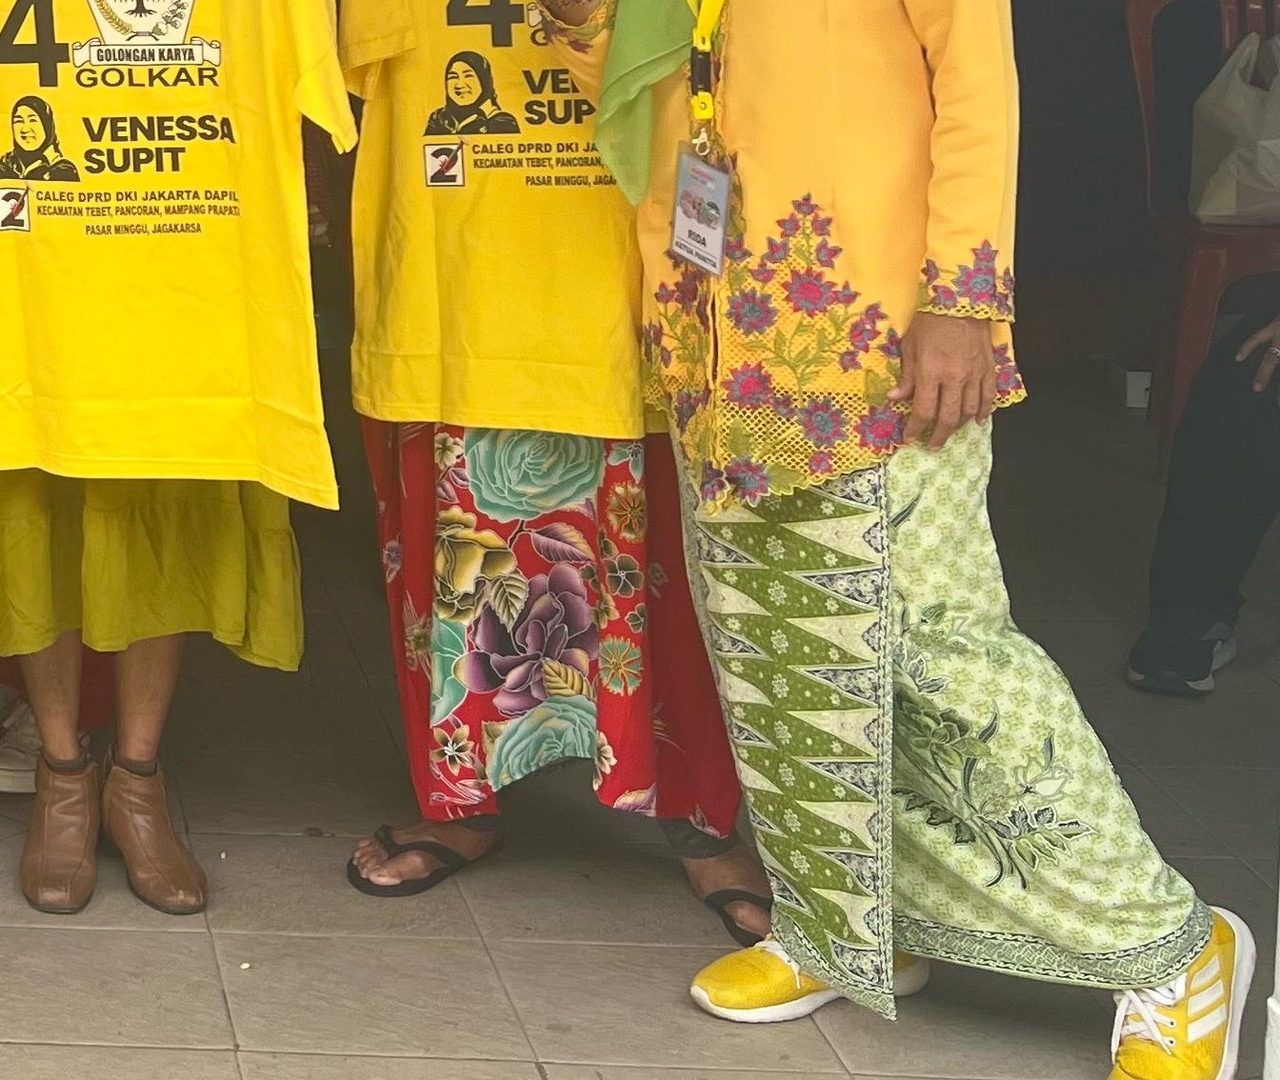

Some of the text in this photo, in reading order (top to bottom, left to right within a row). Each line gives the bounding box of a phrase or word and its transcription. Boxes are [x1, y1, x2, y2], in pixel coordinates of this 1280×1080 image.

[96, 47, 195, 62] GOLONGAN KARYA
[75, 67, 219, 88] GOLKAR
[524, 99, 597, 125] SUP
[82, 114, 236, 144] VENESSA
[472, 143, 514, 154] CALEG
[518, 143, 552, 154] DPRD
[556, 142, 579, 153] DKI
[83, 147, 186, 174] SUPIT
[430, 147, 458, 183] 2
[473, 157, 523, 169] KECAMATAN
[525, 157, 554, 170] TEBET,
[526, 176, 553, 186] PASAR
[554, 176, 591, 187] MINGGU,
[36, 190, 238, 203] CALEG DPRD DKI JAKARTA DAPIL
[1, 192, 26, 227] 2
[37, 205, 83, 216] KECAMATAN
[85, 206, 113, 218] TEBET,
[115, 206, 162, 218] PANCORAN,
[164, 205, 205, 216] MAMPANG
[85, 223, 201, 235] PASAR MINGGU, JAGAKARSA
